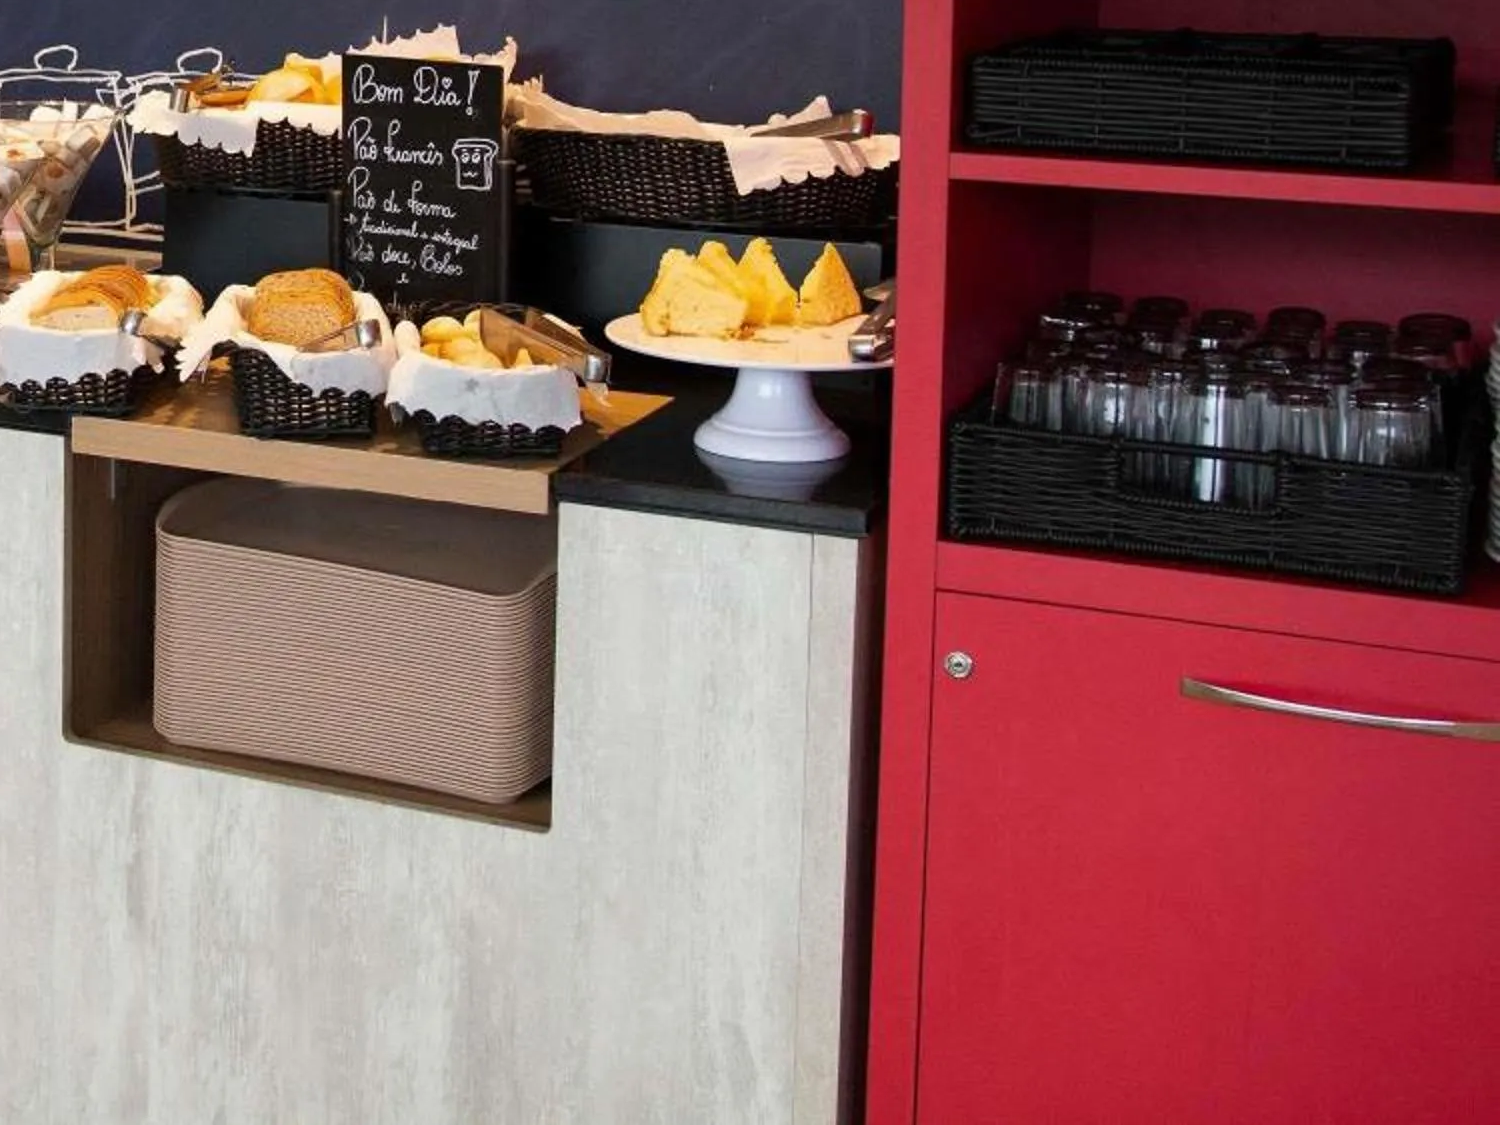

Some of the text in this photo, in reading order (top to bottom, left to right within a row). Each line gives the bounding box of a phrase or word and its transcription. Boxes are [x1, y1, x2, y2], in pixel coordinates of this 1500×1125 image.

[352, 63, 404, 104] Bom
[348, 116, 377, 161] Pão
[348, 166, 376, 210] Pão
[383, 190, 402, 214] de
